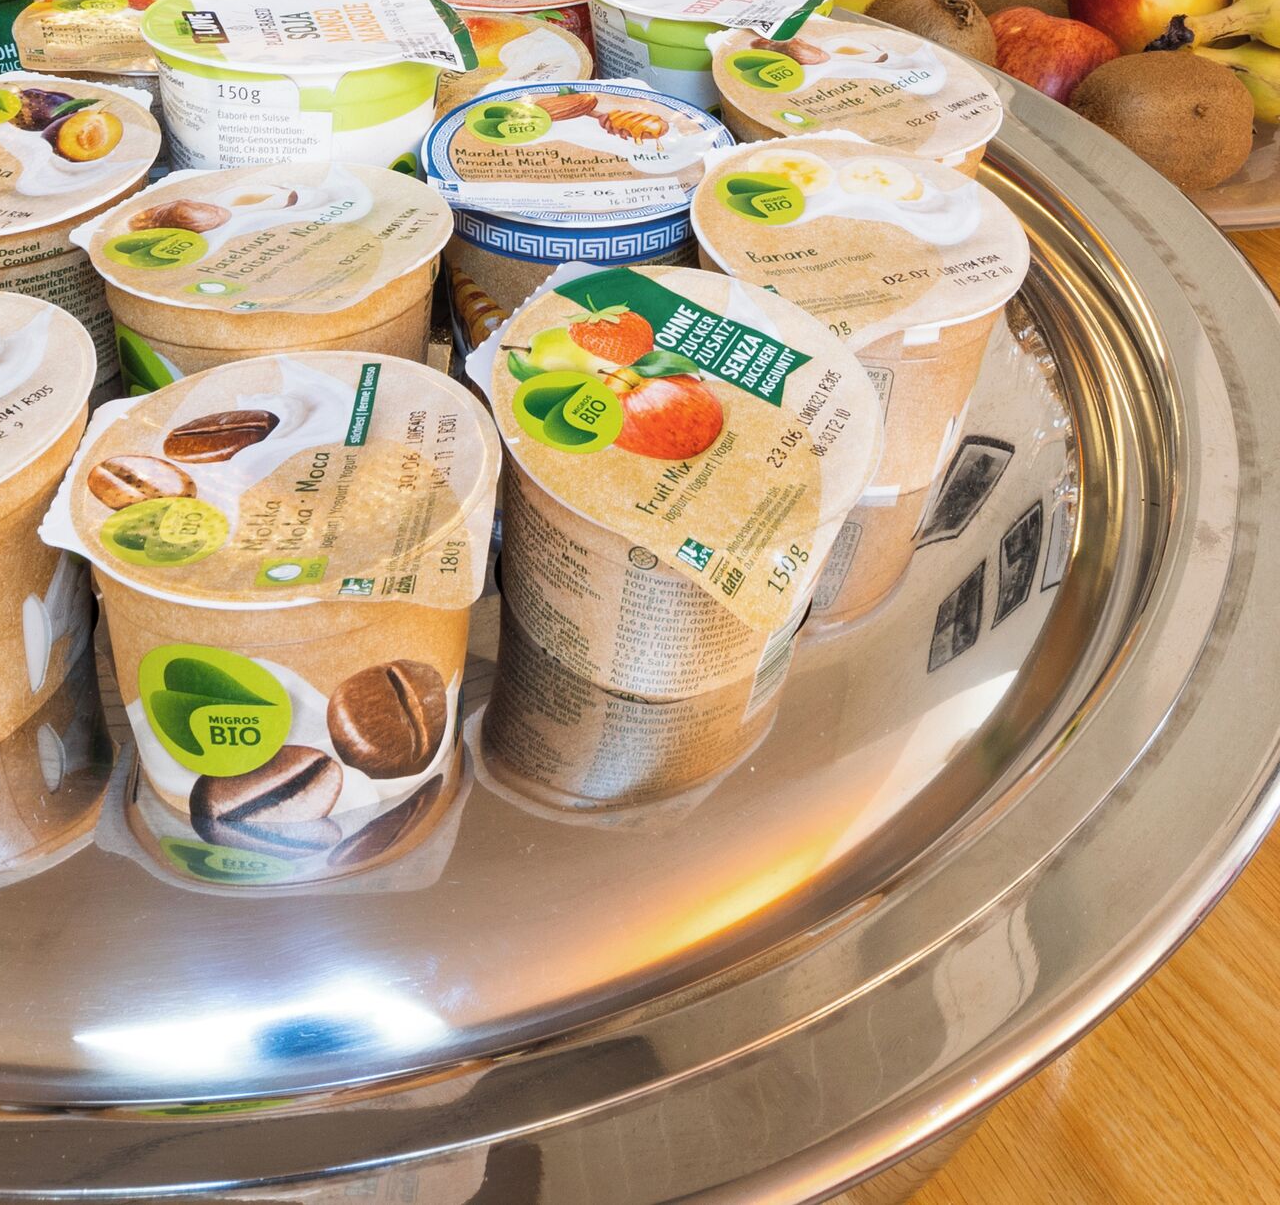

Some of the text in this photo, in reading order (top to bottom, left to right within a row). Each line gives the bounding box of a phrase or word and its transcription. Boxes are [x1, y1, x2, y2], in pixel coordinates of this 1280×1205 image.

[770, 69, 794, 83] BIO
[788, 81, 859, 109] Haselnuss
[807, 68, 932, 117] Noisette Nocciola
[262, 112, 290, 122] Suisse
[508, 124, 536, 135] BIO
[219, 154, 245, 166] Migros
[455, 147, 559, 160] Mandel-Honig
[456, 151, 671, 168] Amande Miel Mandorla Miele
[763, 198, 793, 213] BIO
[166, 241, 194, 256] BIO
[226, 199, 356, 280] Noisette Nocciola
[2, 247, 65, 268] Couvercle
[196, 232, 276, 275] Haselnuss
[745, 246, 819, 264] Banane
[15, 265, 78, 286] Zwetschgen,
[654, 304, 701, 348] OHNE
[677, 316, 719, 356] ZUCKER
[721, 333, 764, 381] SENZA
[739, 343, 779, 389] ZUCCHERI
[20, 385, 54, 407] R305
[571, 394, 592, 416] MIGROS
[579, 399, 607, 426] BIO
[296, 451, 332, 493] Moca
[660, 430, 739, 525] Joghurt Yogourt Yogurt
[635, 461, 693, 516] Fruit Mix
[179, 511, 205, 536] BIO
[239, 499, 282, 551] Mokka
[276, 508, 314, 551] Moka
[624, 569, 688, 591] Nährwerte
[720, 566, 744, 597] data
[621, 597, 717, 618] matières grasses
[622, 588, 666, 606] Energie
[619, 606, 680, 626] Fettsäuren
[616, 633, 647, 648] stoffe
[617, 624, 690, 643] davon Zucker
[611, 658, 677, 678] Certification
[208, 715, 260, 725] MIGROS
[209, 726, 262, 747] BIO
